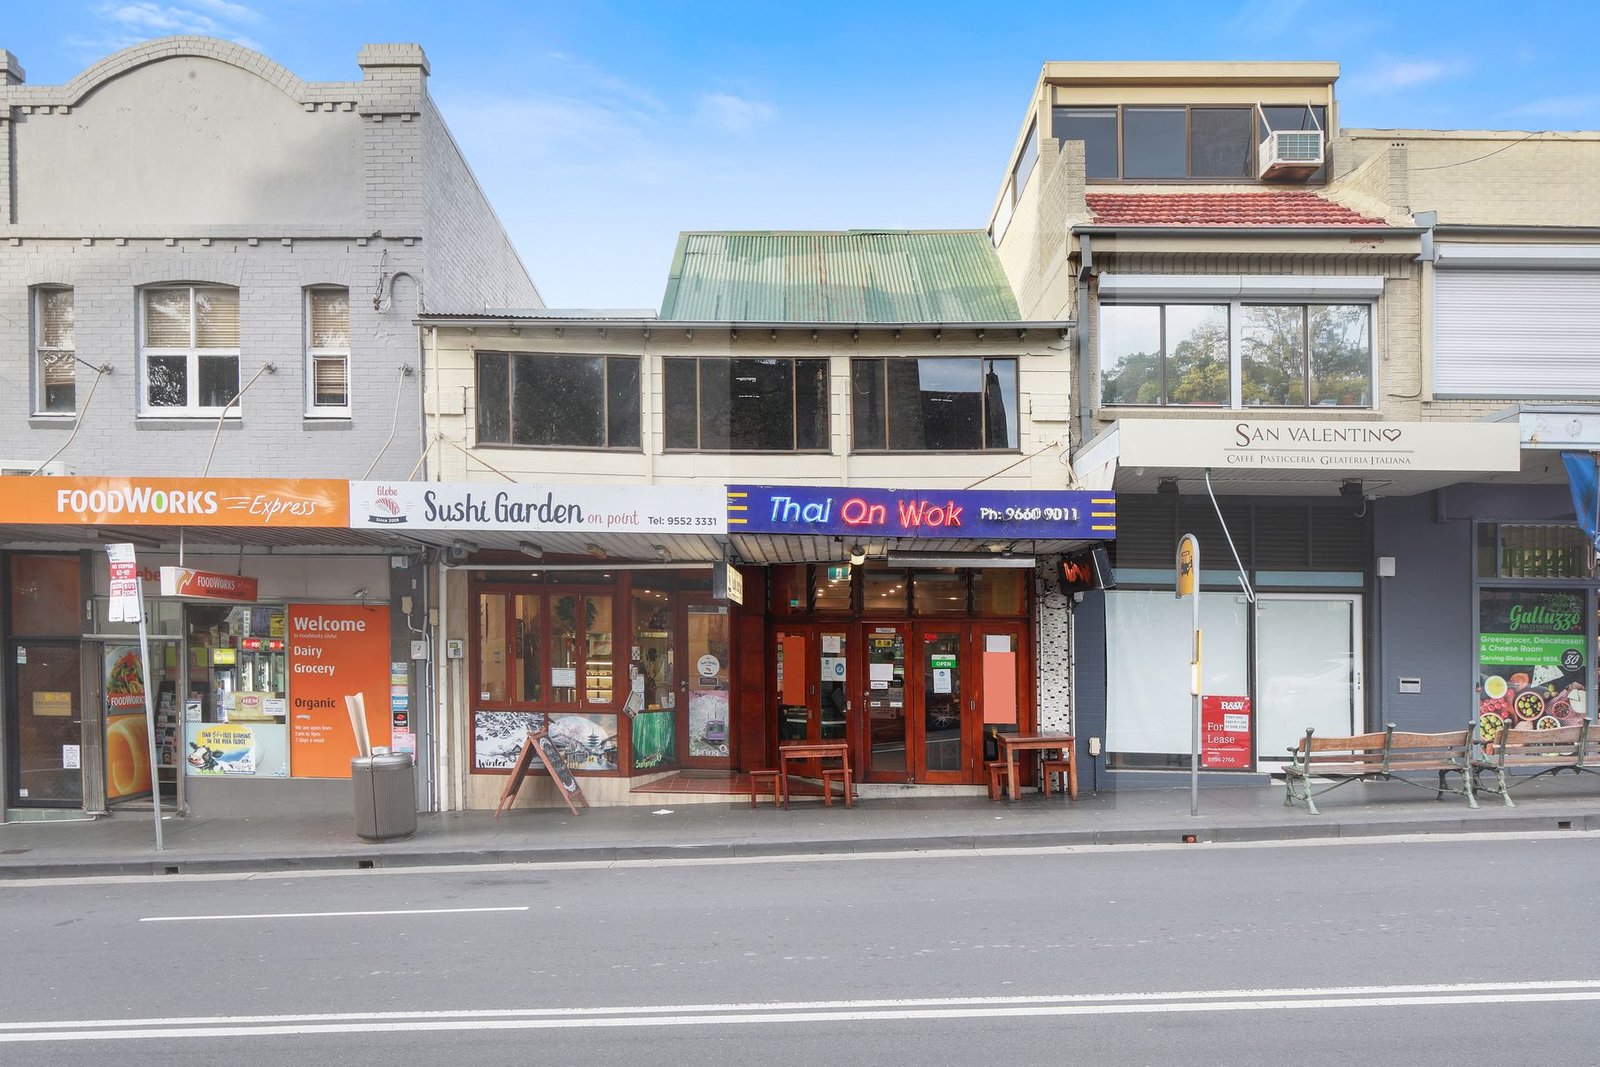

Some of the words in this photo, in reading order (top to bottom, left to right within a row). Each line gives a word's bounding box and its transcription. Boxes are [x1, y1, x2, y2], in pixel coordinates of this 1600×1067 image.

[1235, 423, 1279, 447] SAN
[1260, 454, 1316, 464] PASTICCERIA
[1320, 455, 1368, 466] GELATERIA
[1370, 455, 1411, 466] ITALIANA
[57, 486, 217, 514] FOODWORKS
[249, 495, 317, 523] Express
[424, 490, 490, 523] Sushi
[495, 491, 584, 524] Garden
[587, 513, 602, 524] on
[607, 510, 639, 529] point
[648, 516, 665, 525] Tel:
[667, 516, 692, 526] 9552
[695, 517, 717, 526] 3331
[770, 496, 832, 523] Thai
[840, 498, 886, 525] On
[899, 500, 963, 528] Wok
[980, 508, 1002, 520] Ph:
[1005, 508, 1041, 520] 9660
[1045, 507, 1080, 521] 9011
[136, 566, 161, 582] ebe
[197, 576, 235, 591] FOODWORKS
[293, 615, 366, 631] Welcome
[1509, 604, 1580, 631] Galluzzo
[1480, 635, 1532, 645] Greengrocer,
[1533, 636, 1584, 645] Delicatessen
[293, 645, 322, 659] Dairy
[1520, 645, 1543, 653] Room
[1564, 654, 1580, 665] 80
[293, 663, 336, 677] Grocery
[294, 697, 336, 710] Organic
[1220, 701, 1244, 710] R&W
[1207, 722, 1224, 731] For
[1207, 734, 1235, 744] Lease
[478, 758, 508, 768] Winter
